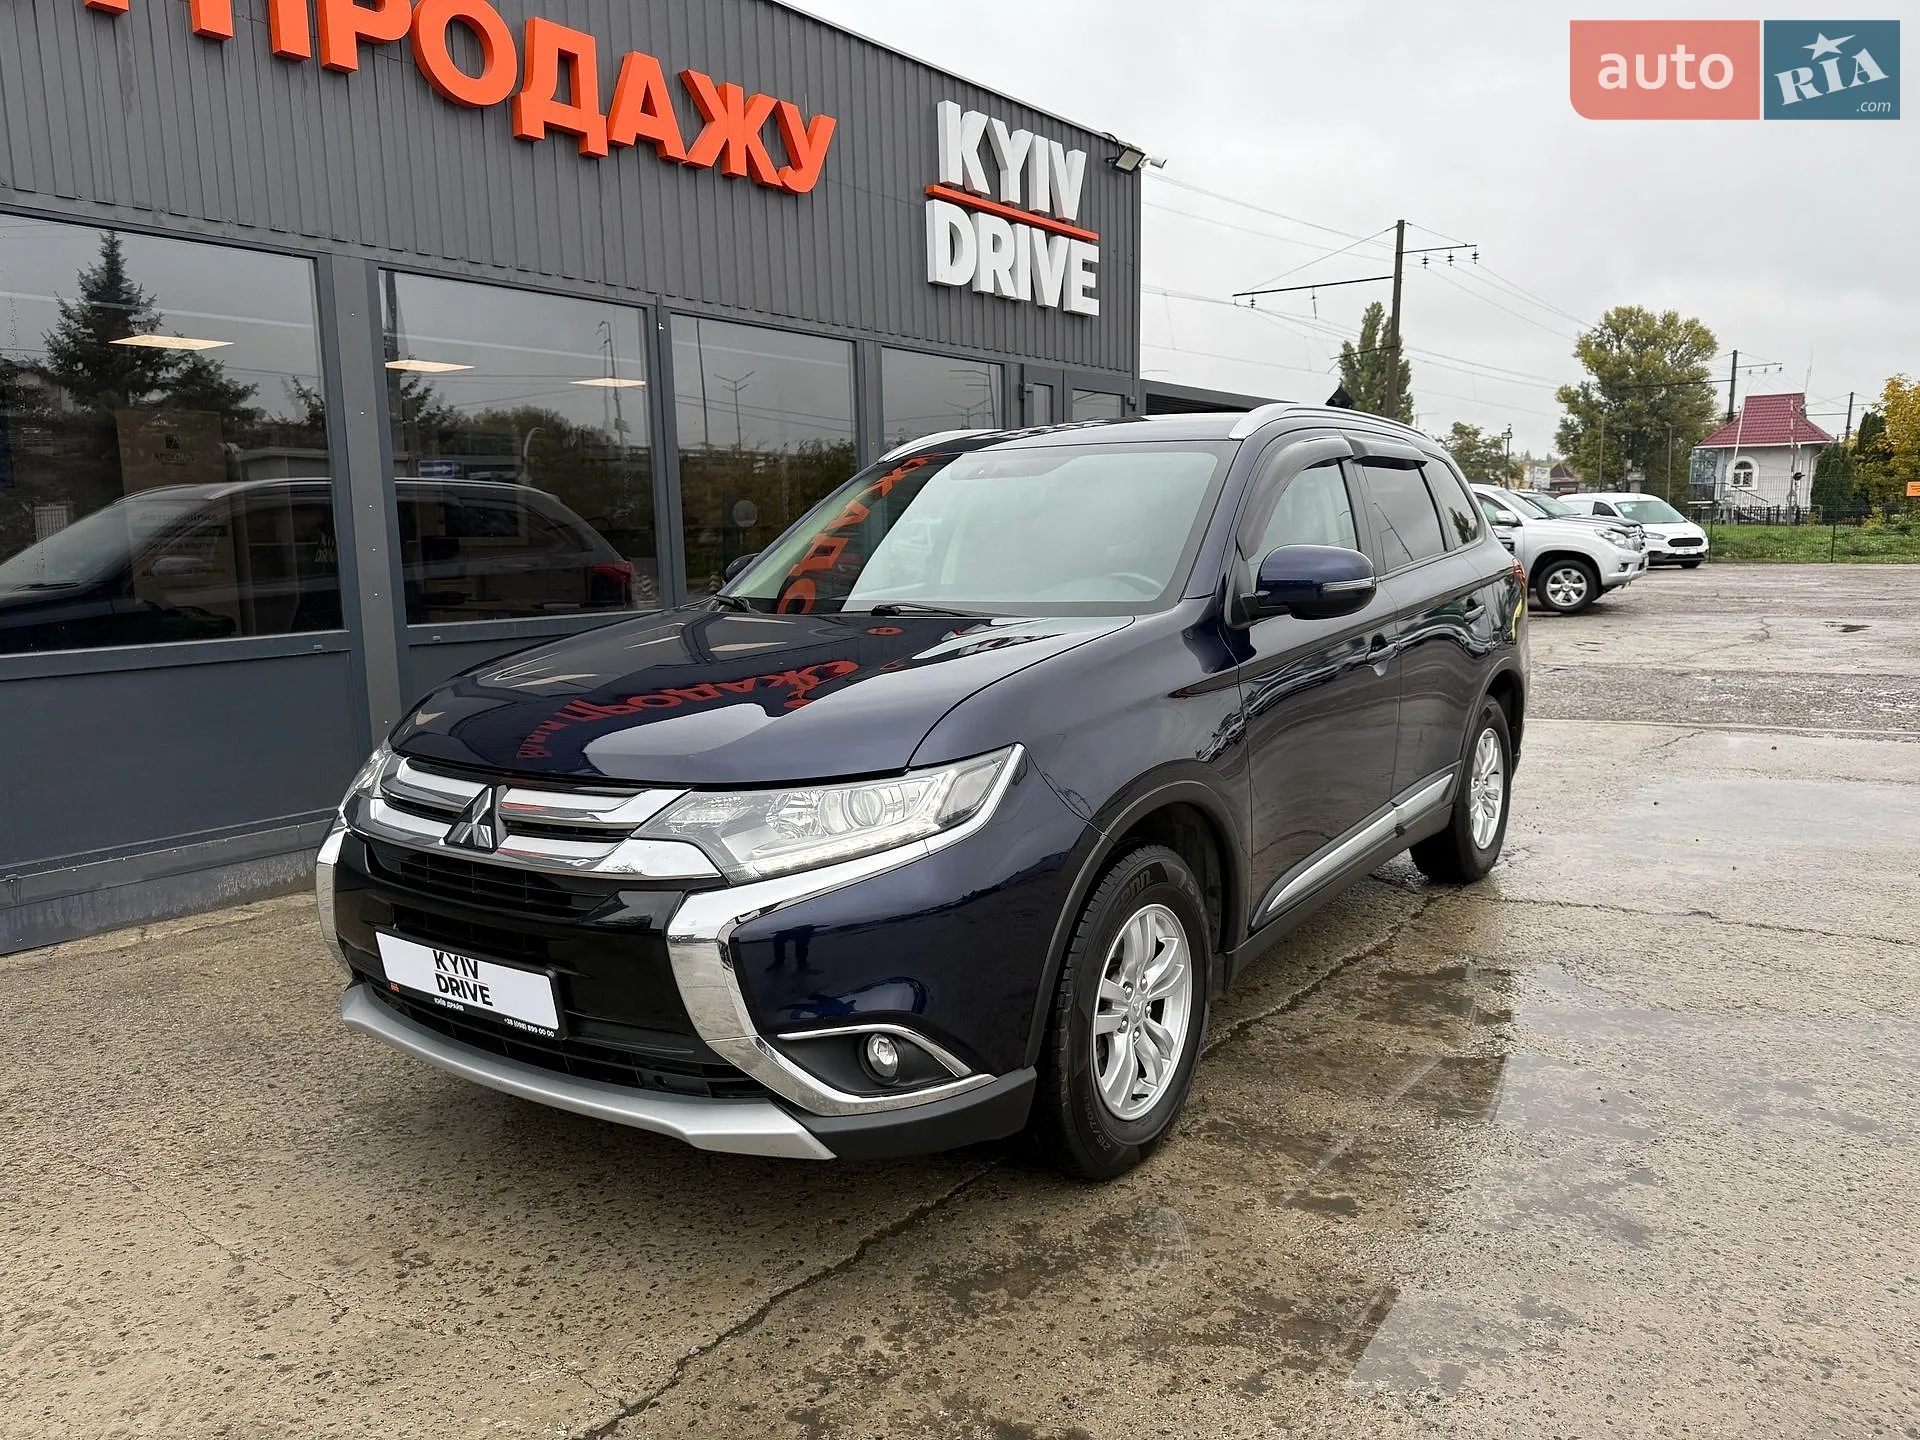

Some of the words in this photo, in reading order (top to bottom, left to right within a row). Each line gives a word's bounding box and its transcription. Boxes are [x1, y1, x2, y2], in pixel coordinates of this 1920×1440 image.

[937, 100, 1087, 221] KYIV
[926, 199, 1100, 316] DRIVE
[433, 950, 479, 980] KYIV
[435, 972, 494, 1007] DRIVE
